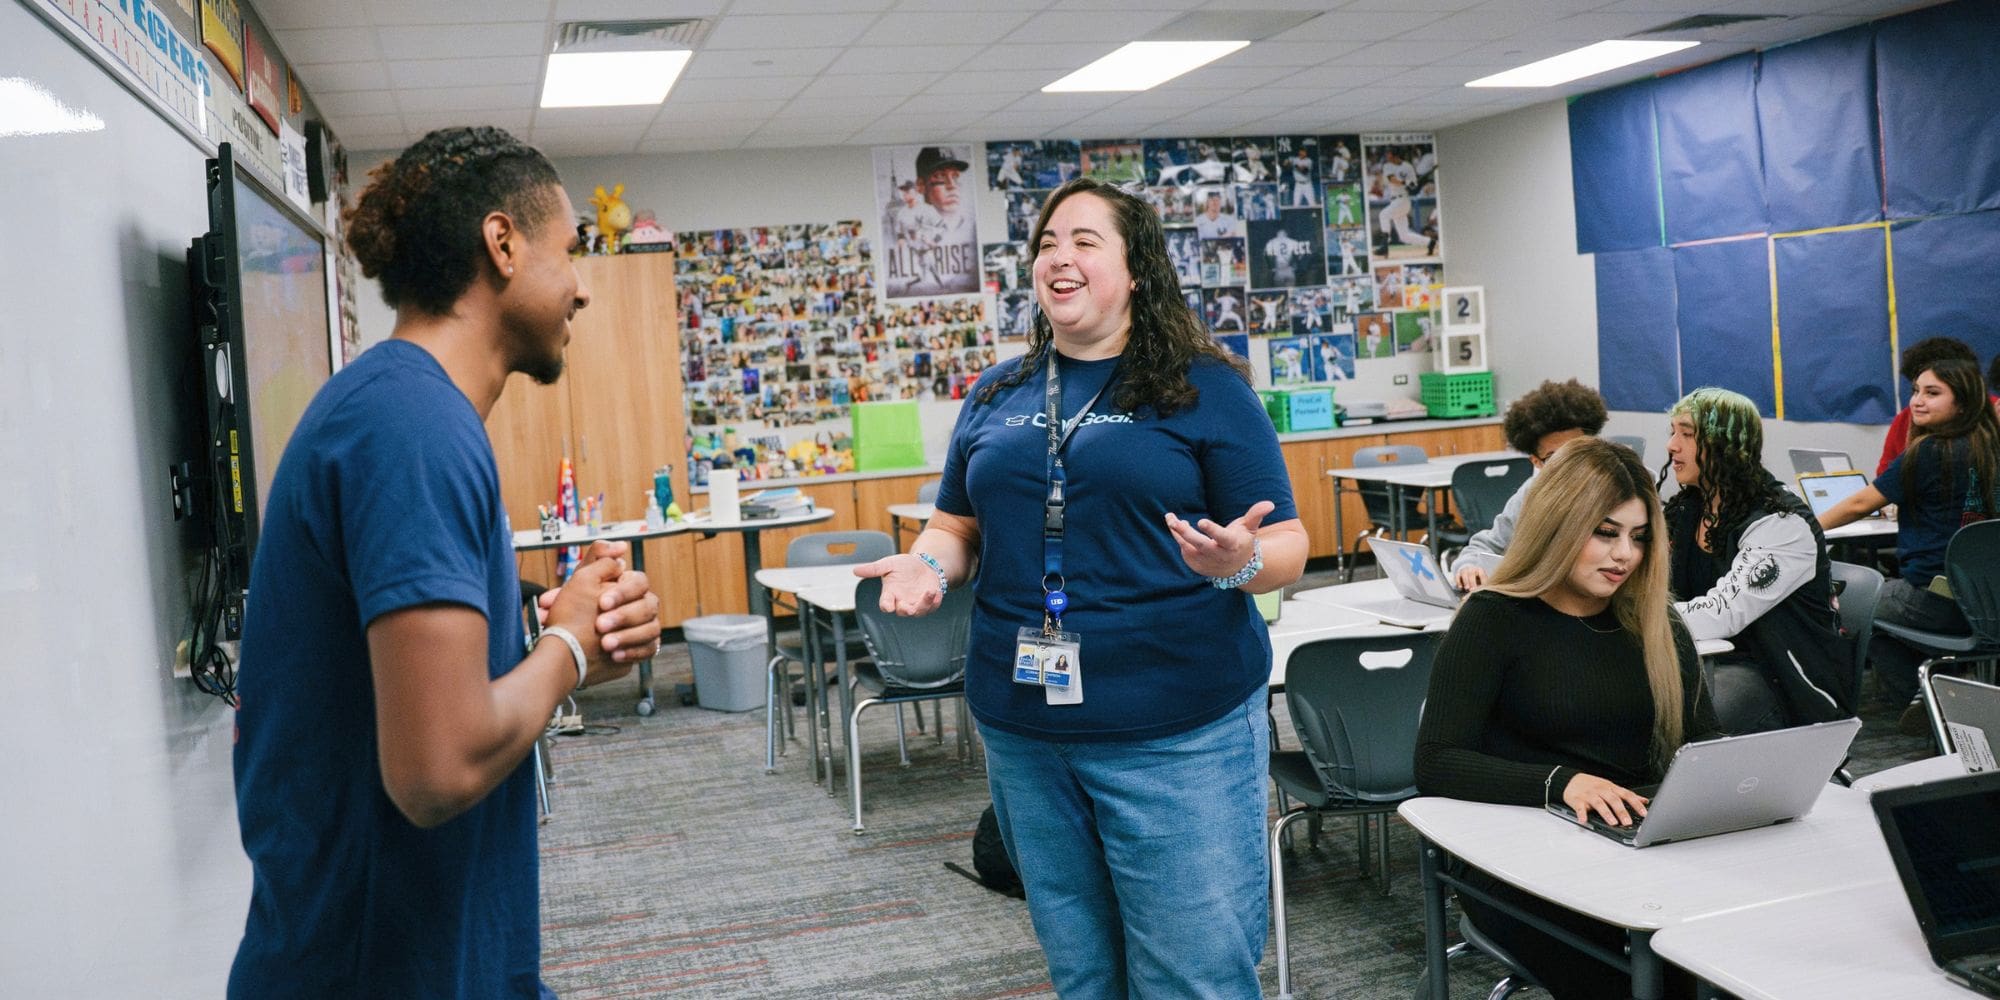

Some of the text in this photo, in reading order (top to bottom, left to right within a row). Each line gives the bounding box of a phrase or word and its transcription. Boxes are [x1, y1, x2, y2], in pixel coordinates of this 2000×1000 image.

[119, 0, 211, 97] EGERS
[889, 243, 972, 278] ALL RISE
[1457, 297, 1470, 318] 2
[1460, 341, 1472, 361] 5
